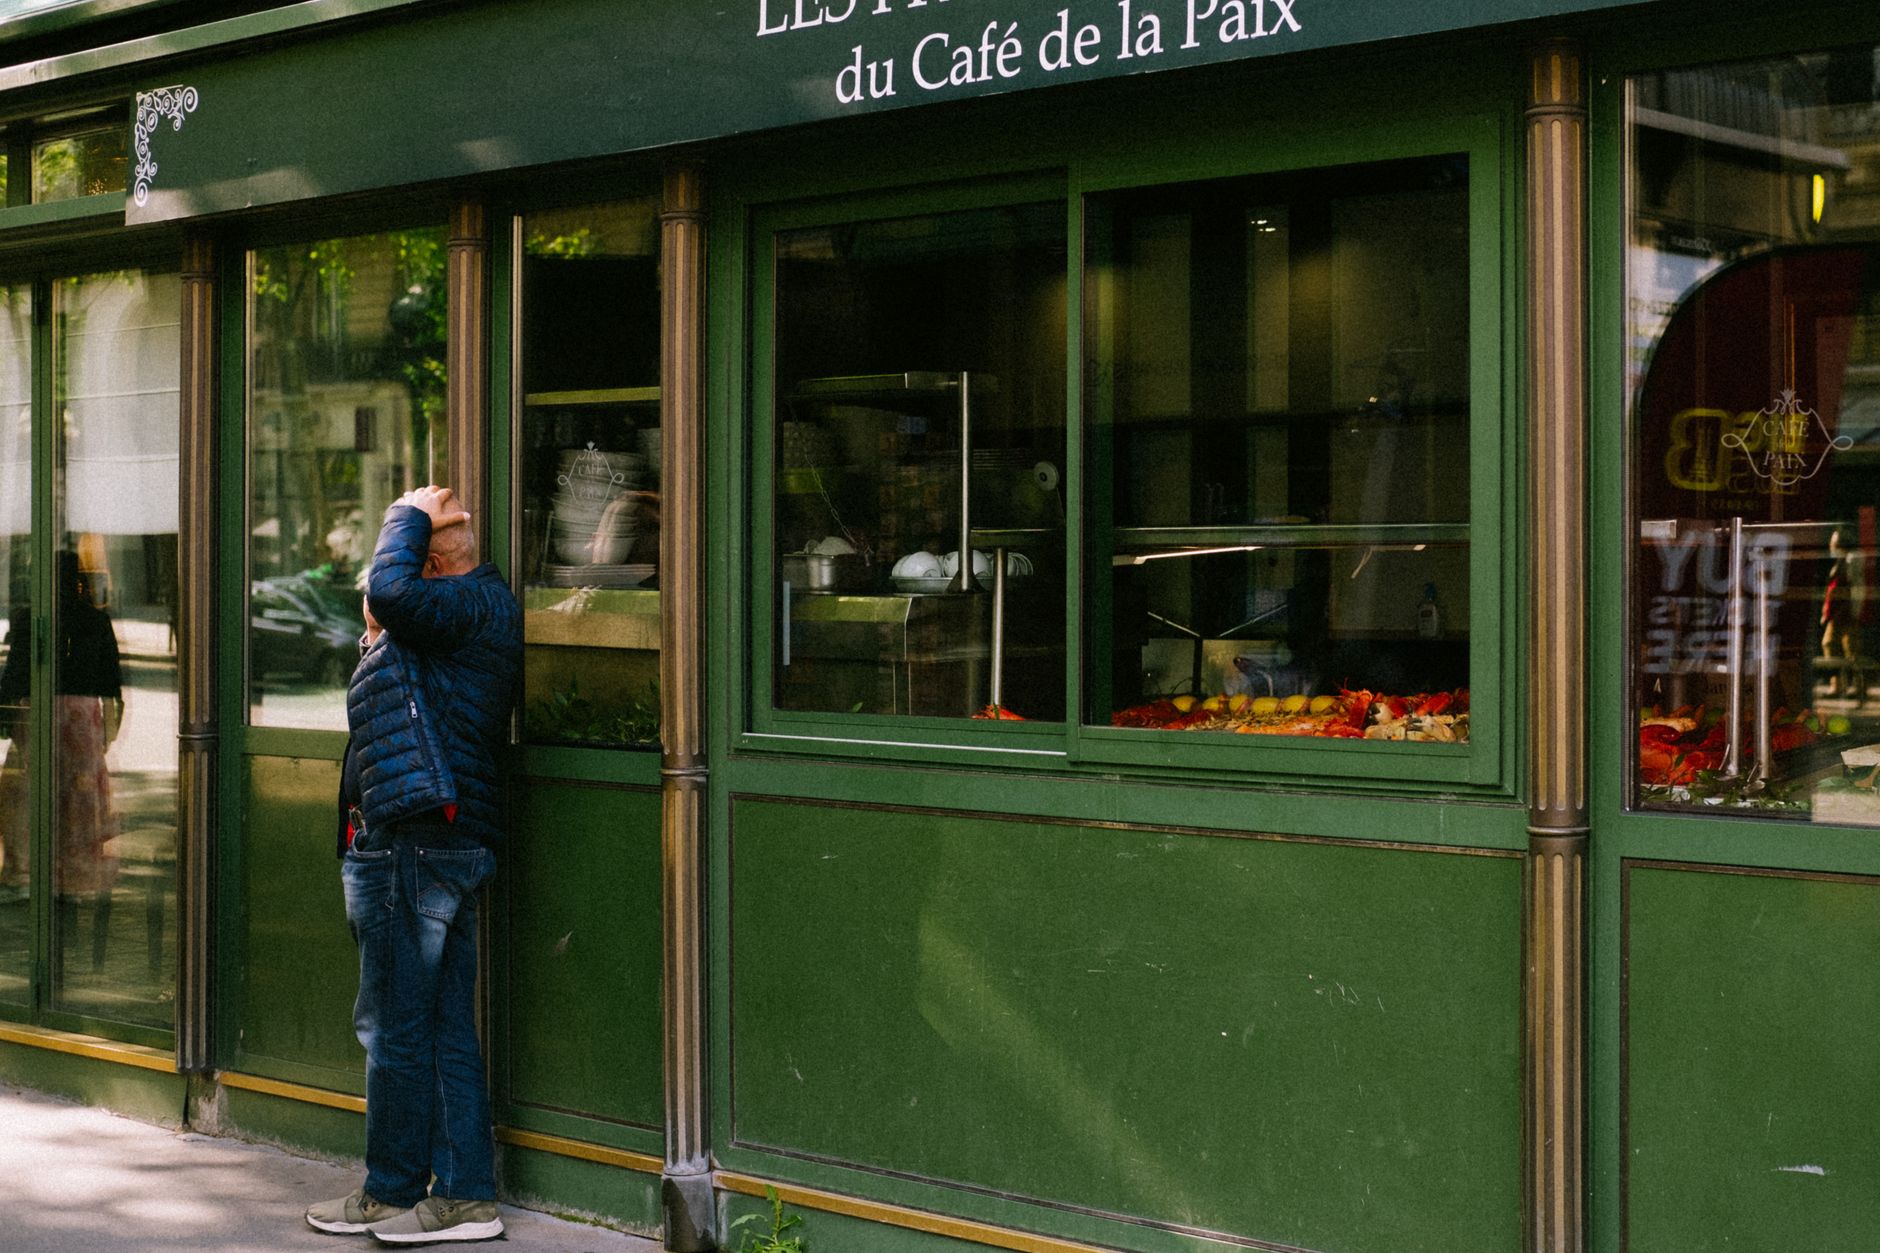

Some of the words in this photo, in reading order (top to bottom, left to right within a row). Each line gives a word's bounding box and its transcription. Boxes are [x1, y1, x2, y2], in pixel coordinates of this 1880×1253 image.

[835, 44, 897, 104] du
[911, 20, 1022, 90] Café
[1038, 8, 1101, 72] de
[1116, 0, 1164, 60] la
[1179, 0, 1302, 49] Paix
